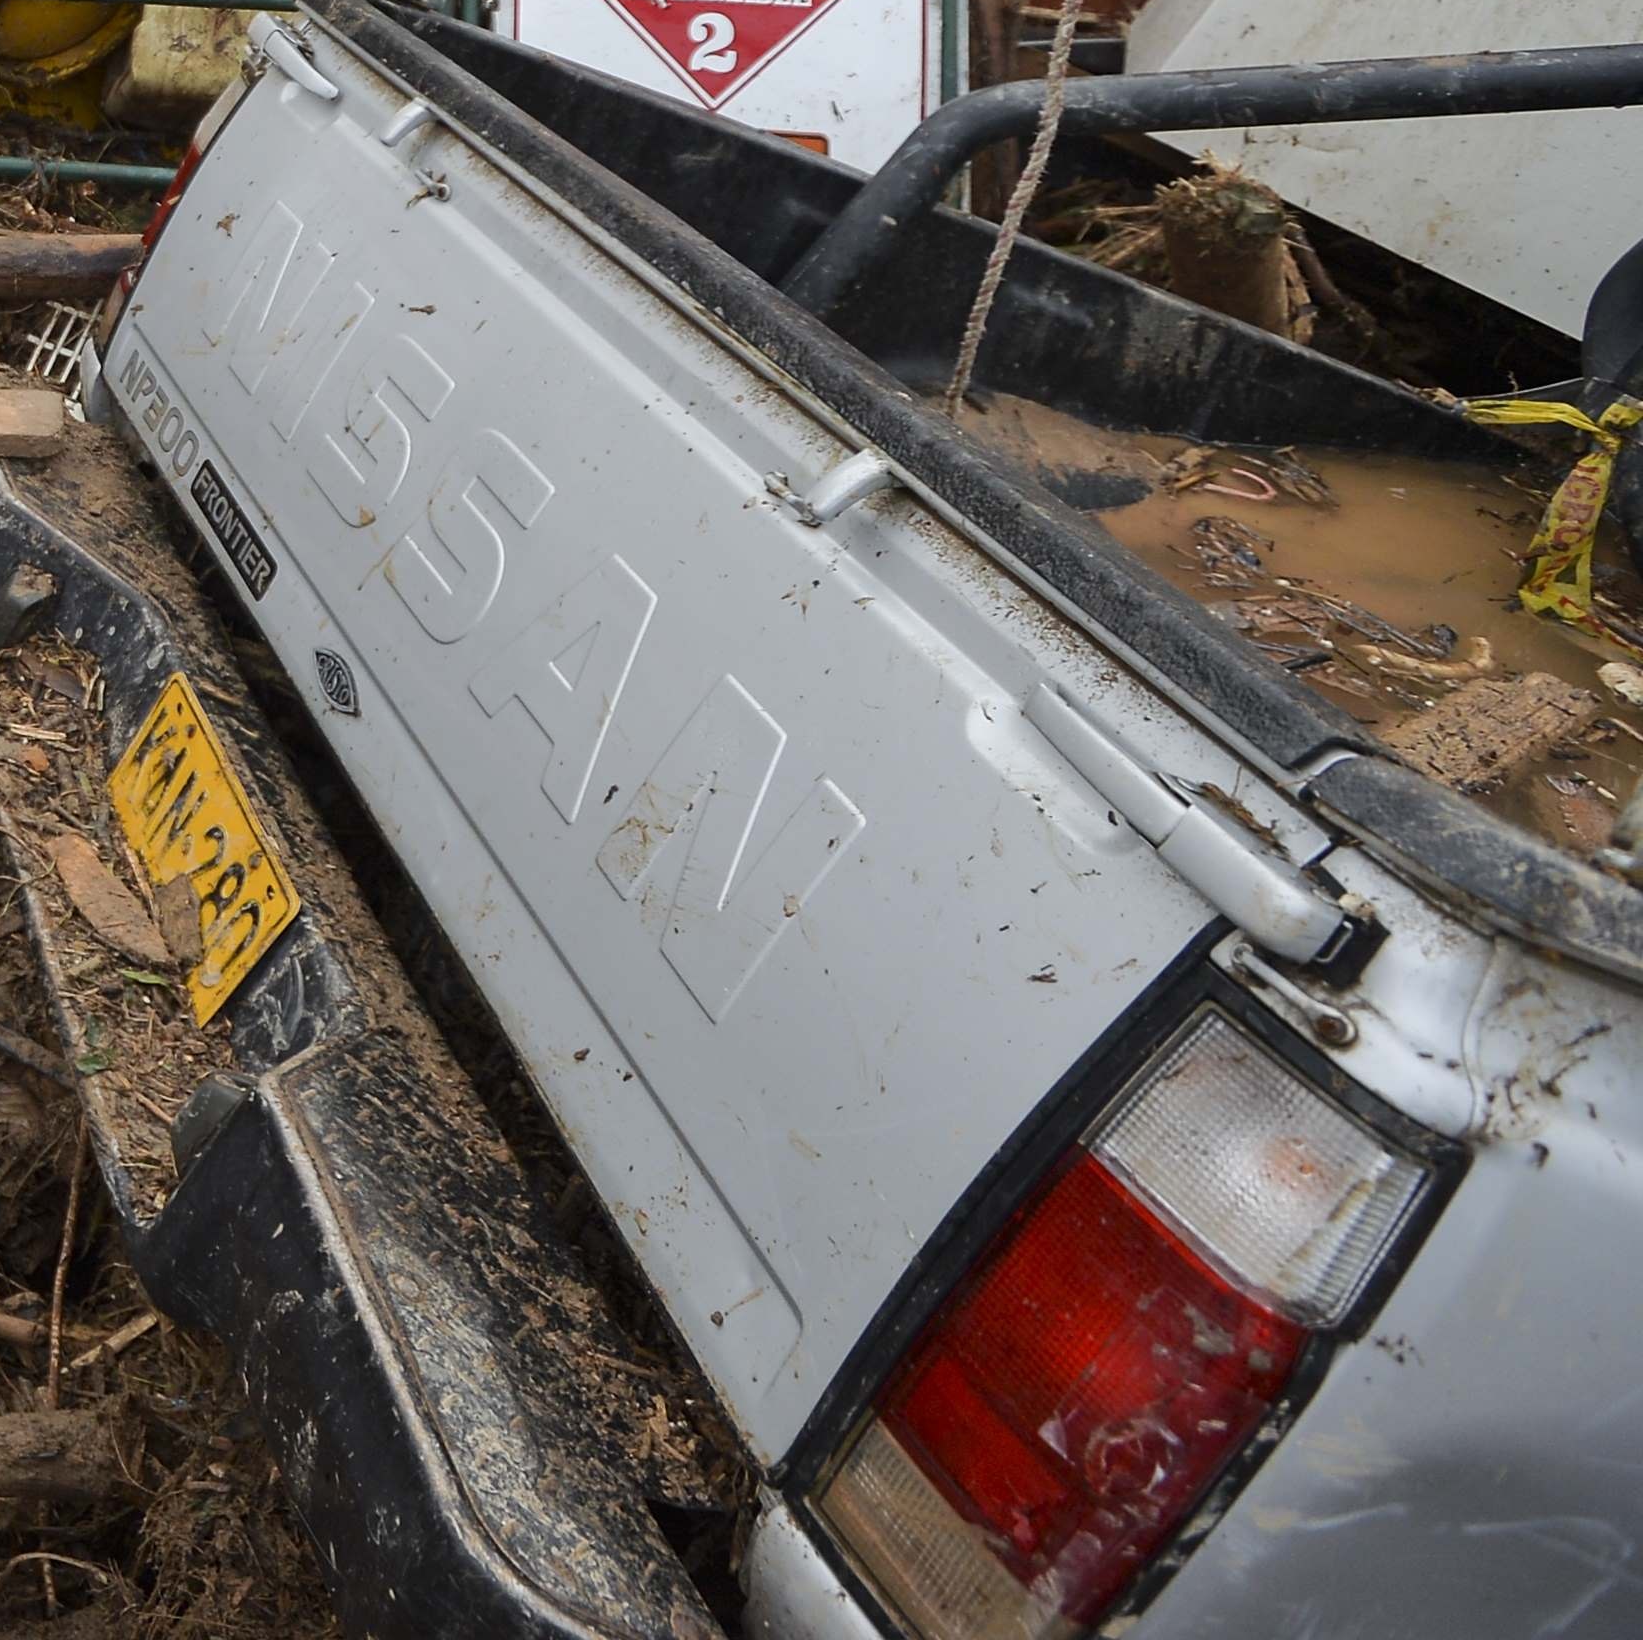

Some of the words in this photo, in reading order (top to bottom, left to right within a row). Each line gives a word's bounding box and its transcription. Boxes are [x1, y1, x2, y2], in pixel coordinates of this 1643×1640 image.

[688, 11, 738, 74] 2
[119, 349, 200, 477] NP300
[193, 466, 273, 596] FRONTIER
[202, 201, 865, 1025] NISSAN
